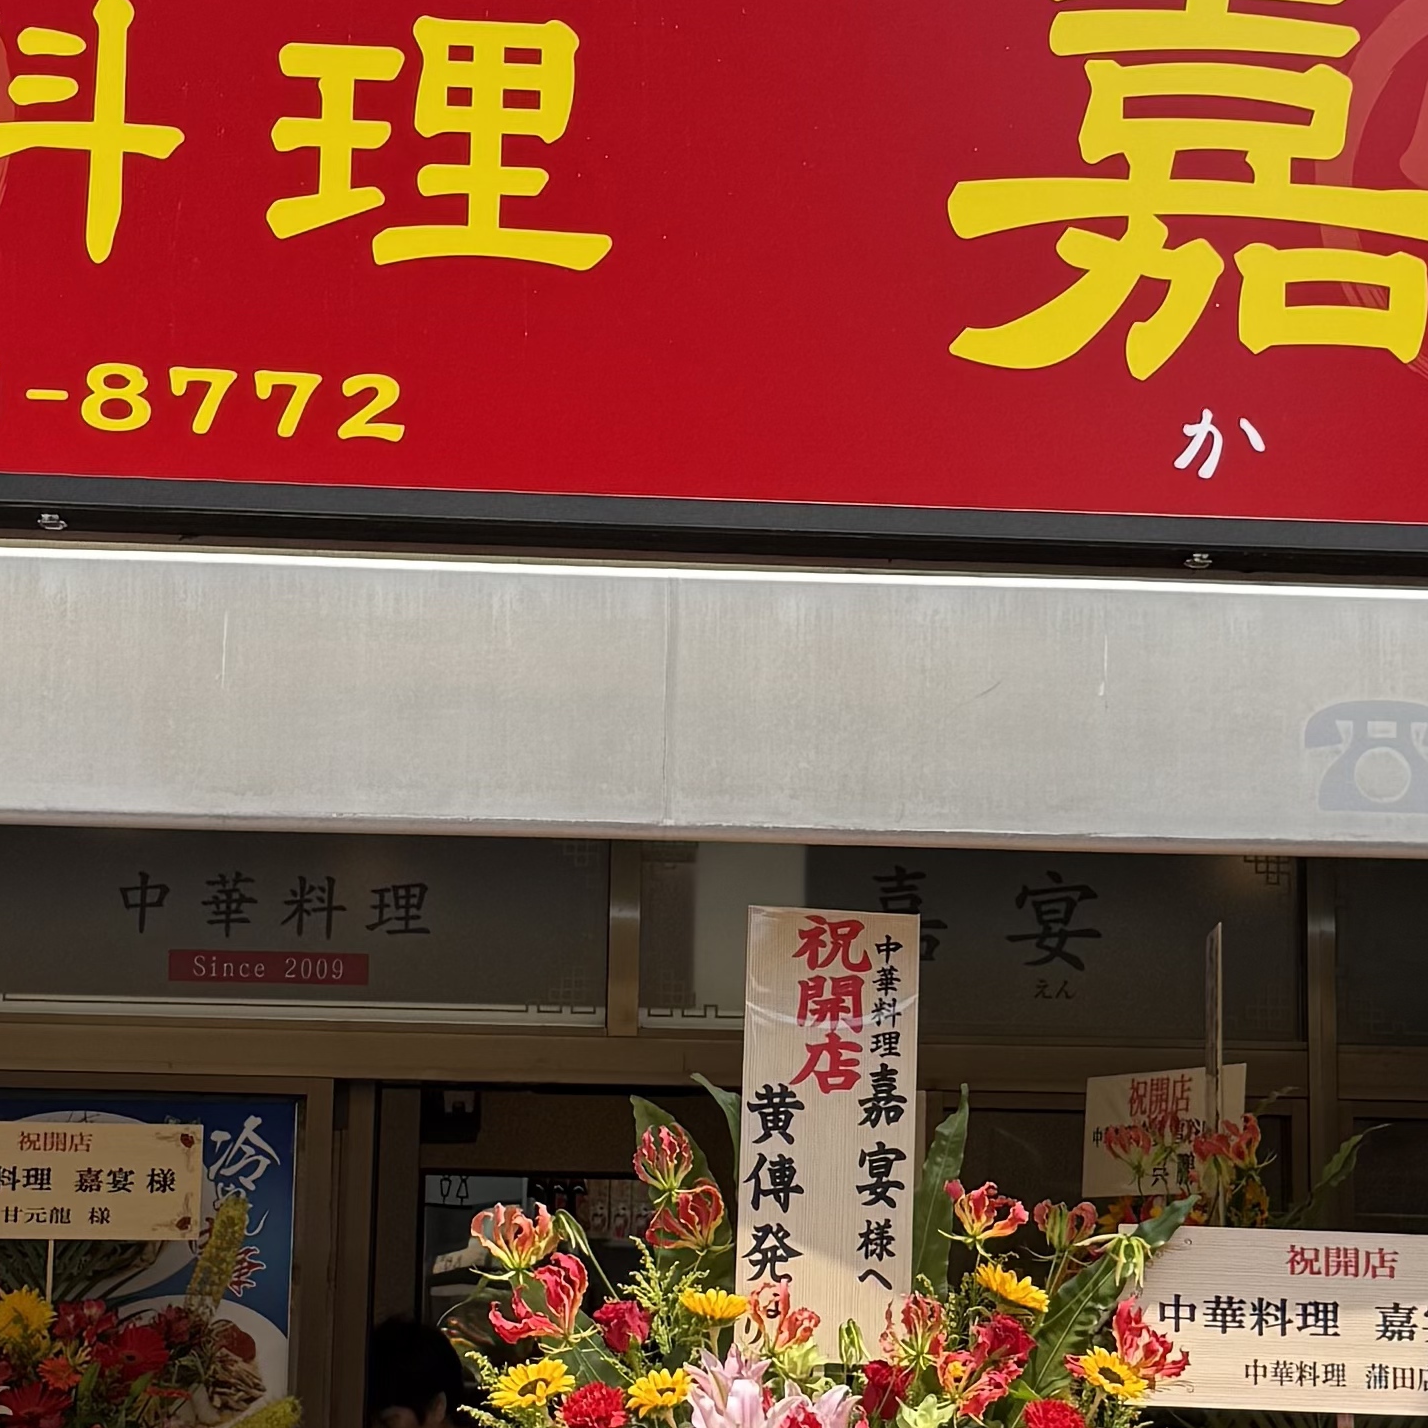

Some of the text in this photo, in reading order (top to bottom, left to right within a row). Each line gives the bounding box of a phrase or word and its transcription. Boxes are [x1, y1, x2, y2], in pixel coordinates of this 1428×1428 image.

[1174, 406, 1265, 482] か
[120, 870, 431, 940] 中華料理
[192, 954, 346, 982] Since 2009
[790, 915, 872, 1094] 祝開店
[1128, 1074, 1194, 1118] 祝開店
[18, 1130, 93, 1153] 祝開店
[74, 1167, 136, 1194] 嘉宴
[146, 1168, 177, 1194] 様
[88, 1207, 111, 1225] 様
[1285, 1244, 1400, 1280] 祝開店
[1158, 1294, 1340, 1339] 中華料理
[1243, 1358, 1347, 1390] 中華料理
